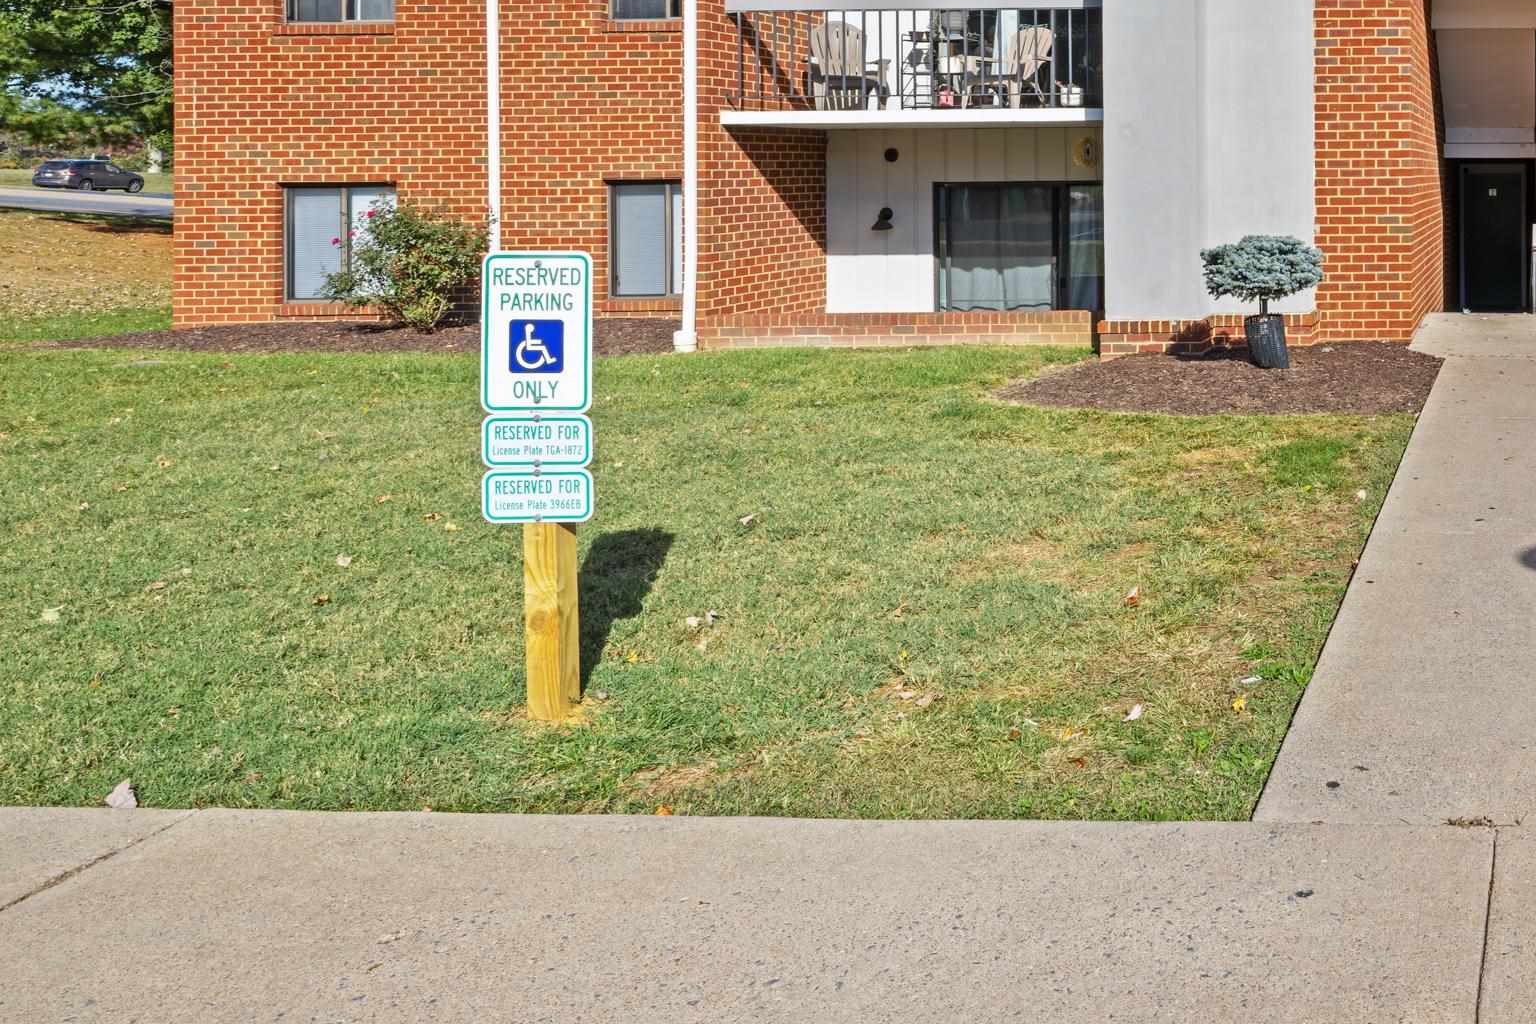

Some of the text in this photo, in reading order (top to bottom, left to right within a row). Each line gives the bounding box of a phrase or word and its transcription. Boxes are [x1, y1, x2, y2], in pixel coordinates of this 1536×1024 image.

[493, 267, 581, 286] RESERVED
[500, 292, 574, 311] PARKING
[513, 380, 559, 399] ONLY
[494, 425, 580, 440] RESERVED FOR
[492, 445, 520, 456] License
[523, 445, 543, 456] Plate
[495, 479, 581, 495] RESERVED FOR
[494, 499, 524, 511] License
[527, 499, 548, 510] Plate
